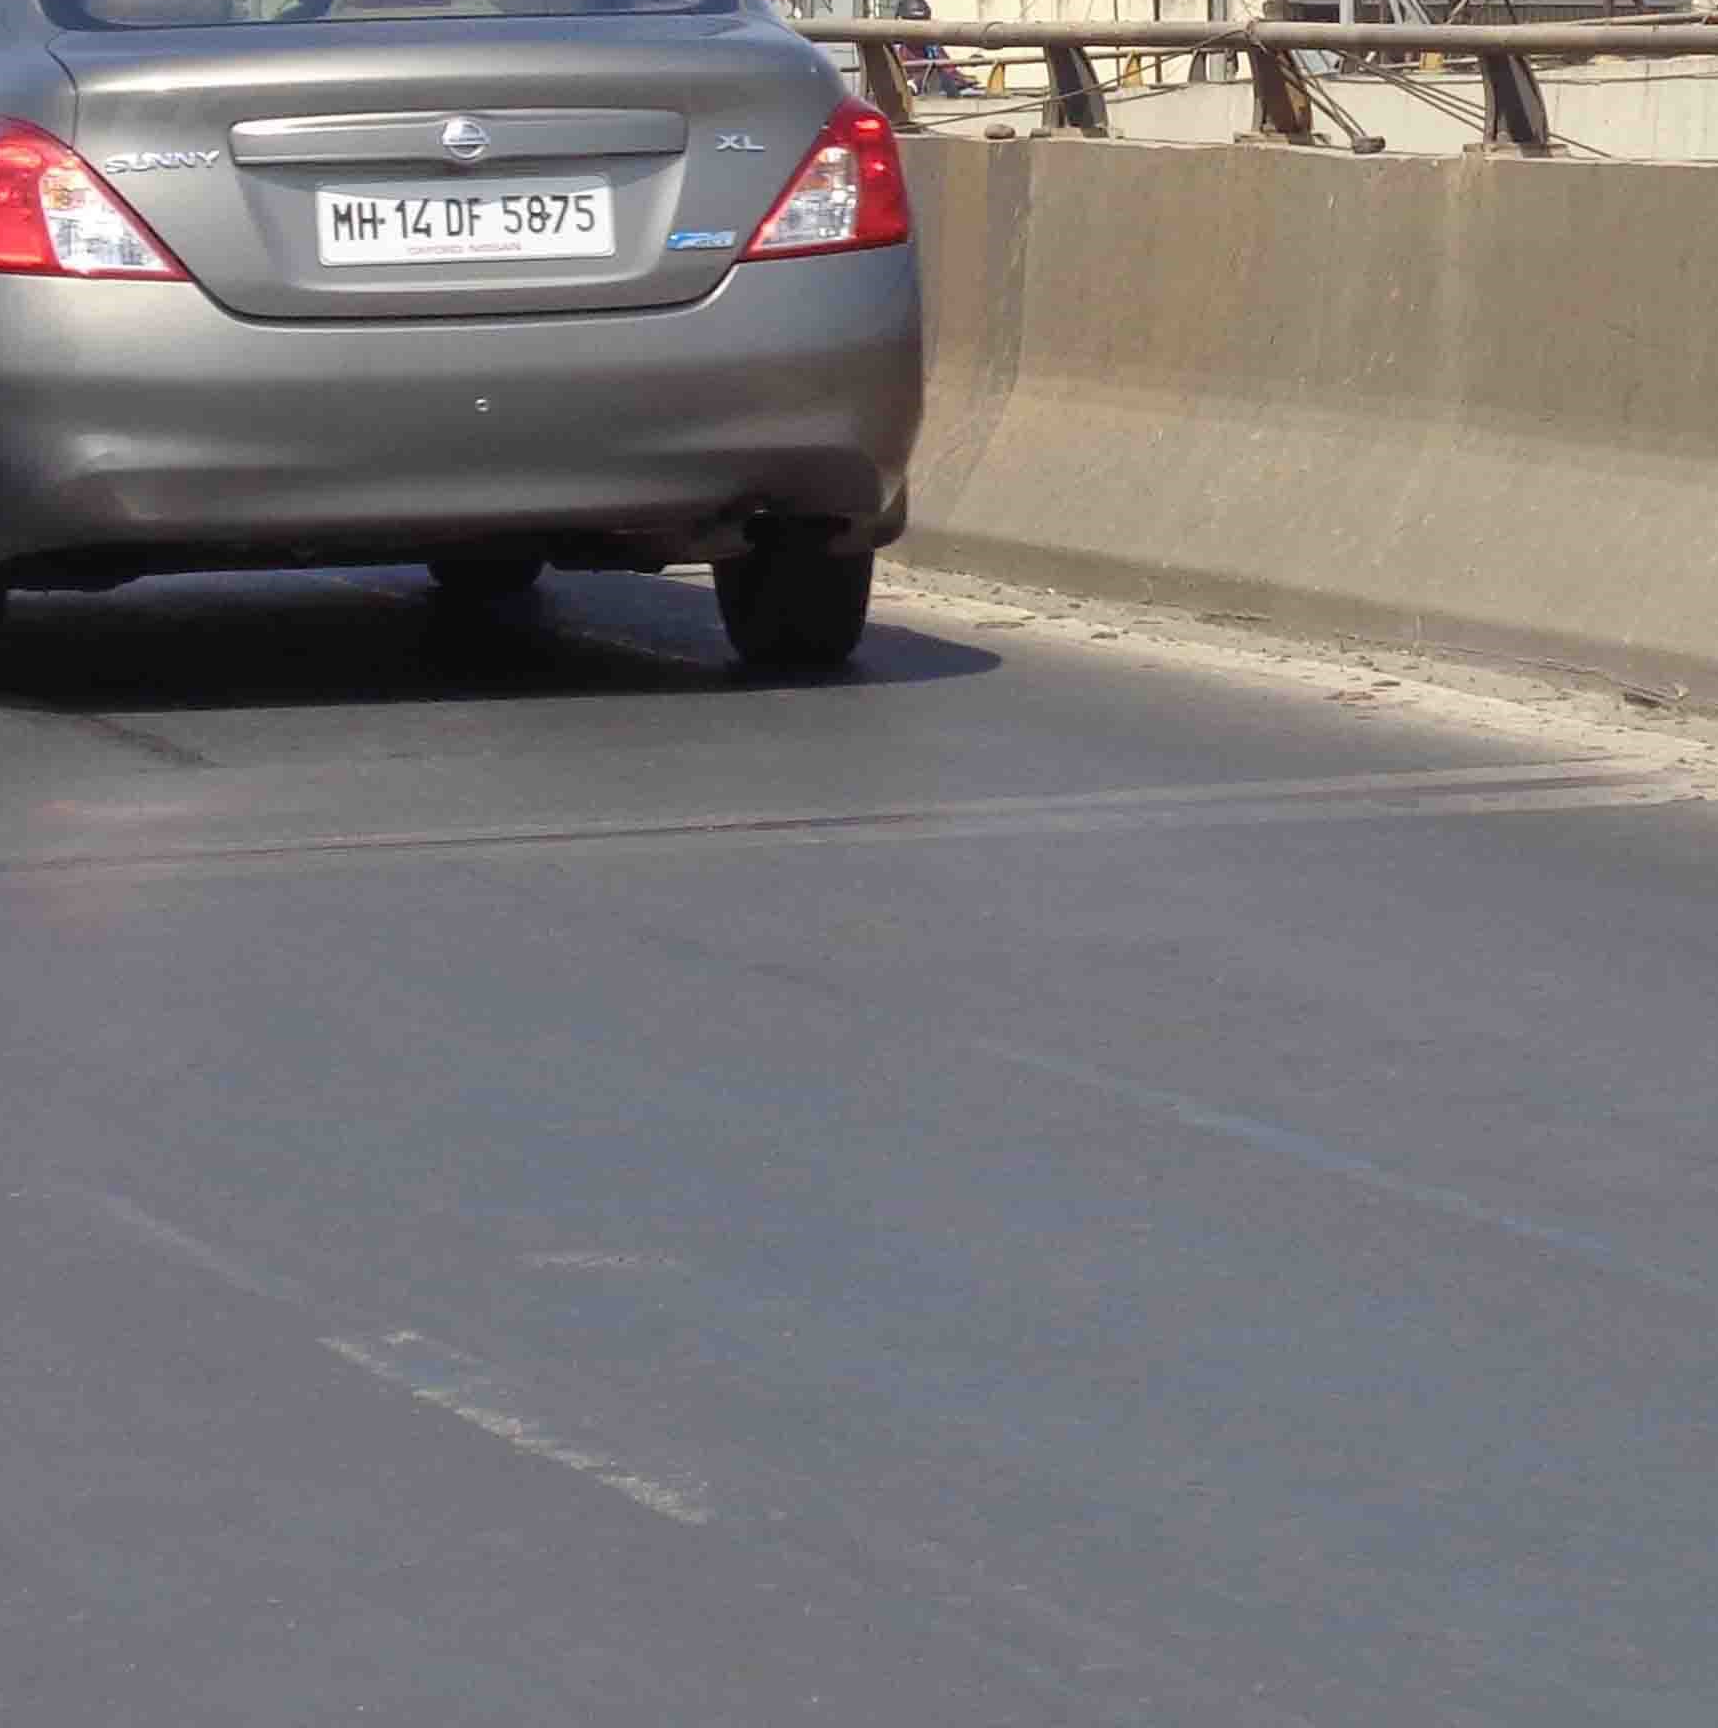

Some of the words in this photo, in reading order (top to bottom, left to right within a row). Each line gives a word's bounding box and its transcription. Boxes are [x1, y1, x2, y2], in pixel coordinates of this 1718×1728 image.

[715, 135, 766, 152] XL
[106, 150, 220, 173] SUNNY
[501, 195, 596, 233] 5875
